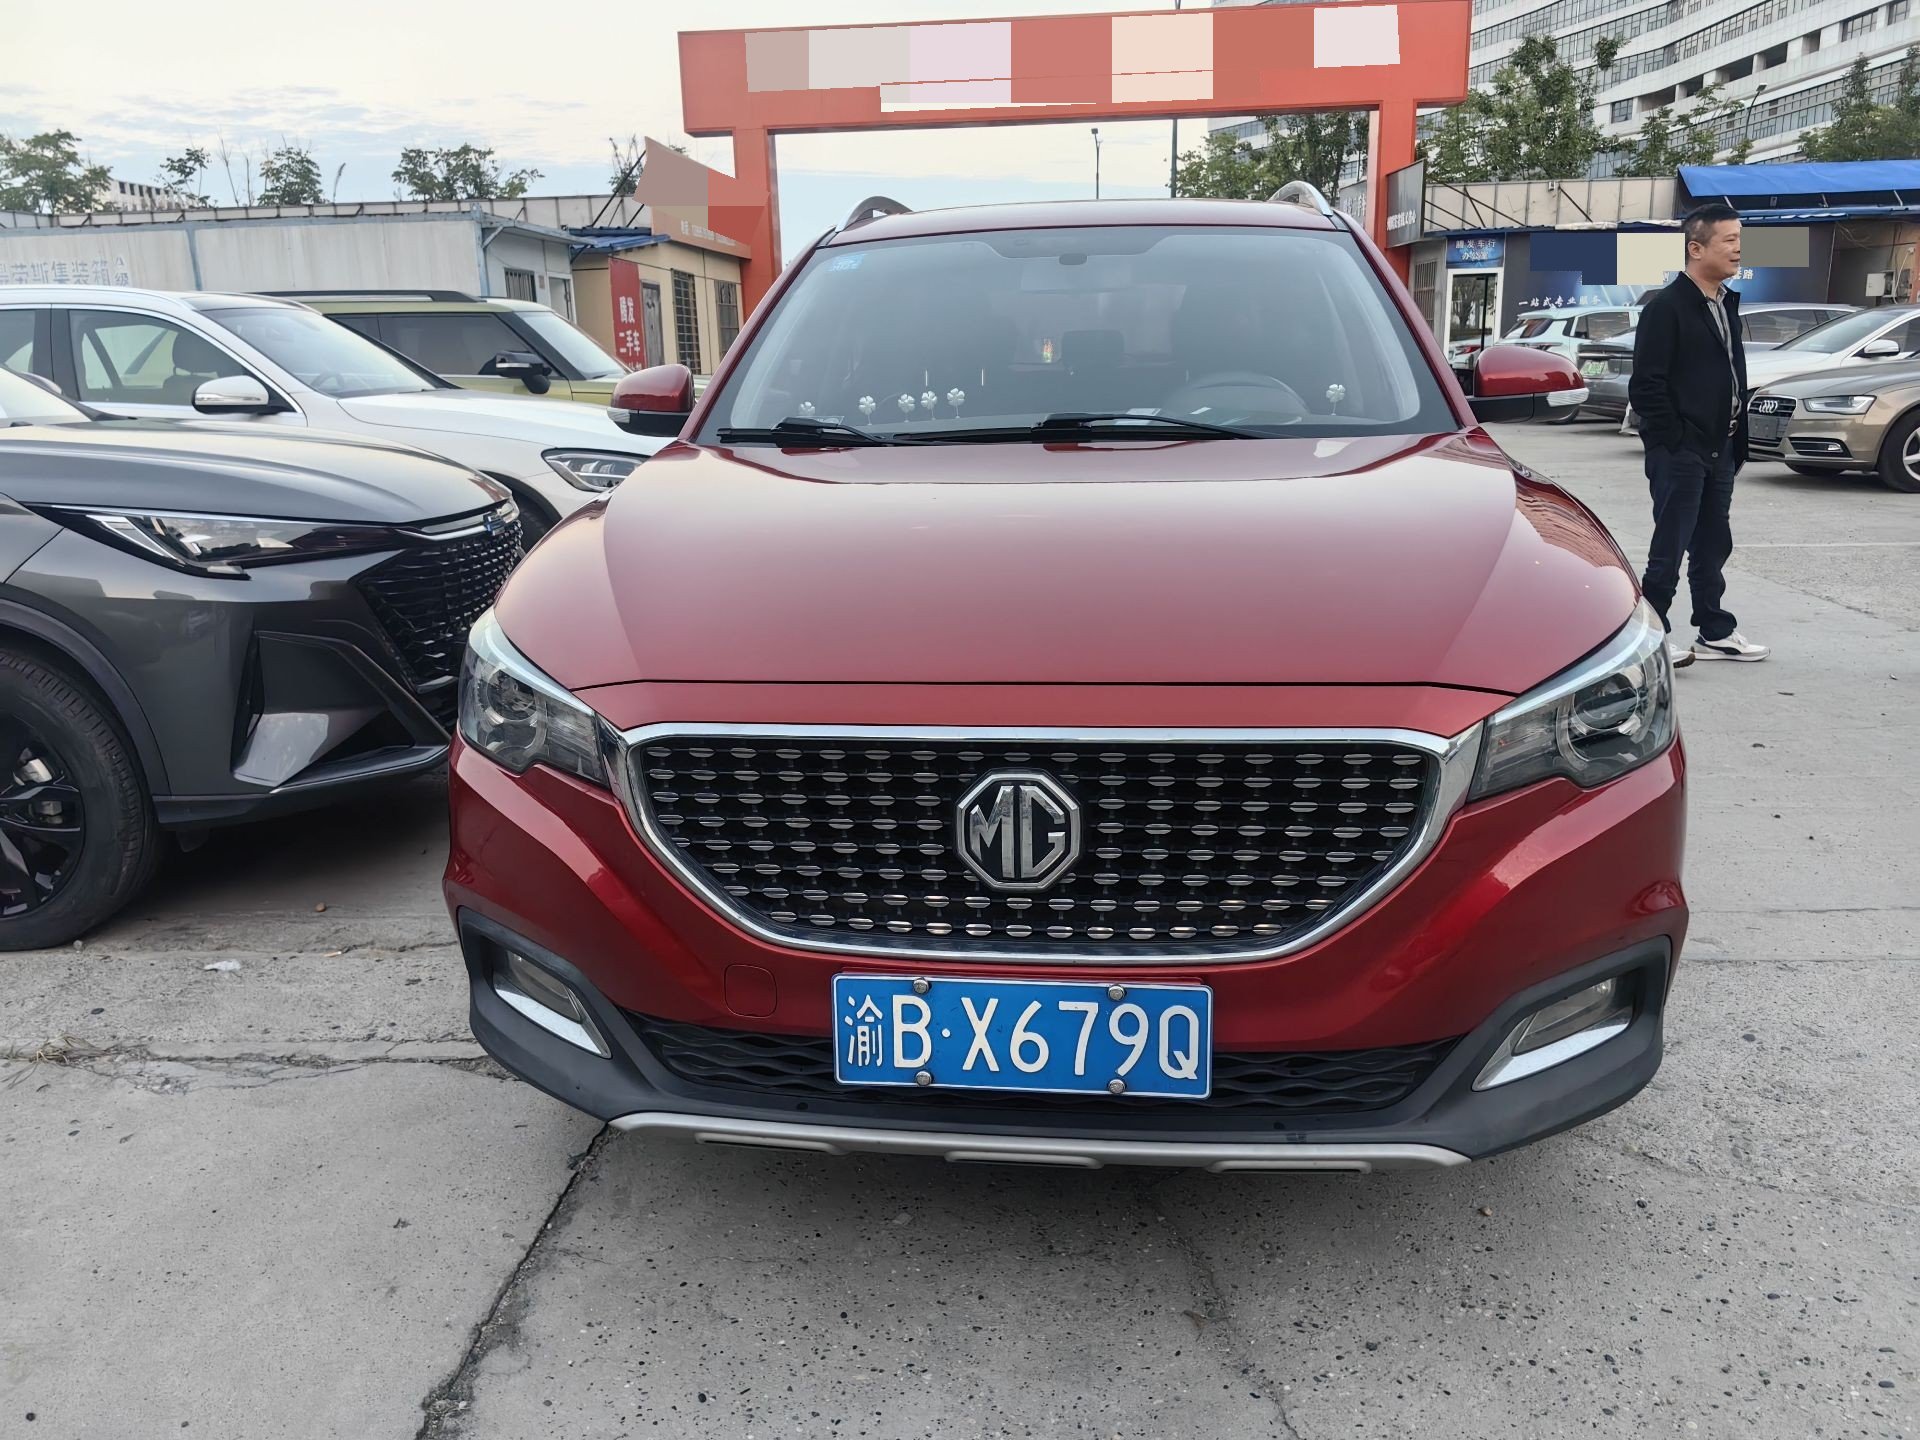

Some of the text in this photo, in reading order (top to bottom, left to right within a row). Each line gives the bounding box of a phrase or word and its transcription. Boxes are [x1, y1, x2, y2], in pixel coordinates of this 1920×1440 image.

[1518, 295, 1601, 308] 一站式专业服务
[619, 330, 641, 357] 二手车
[969, 785, 1066, 879] MG
